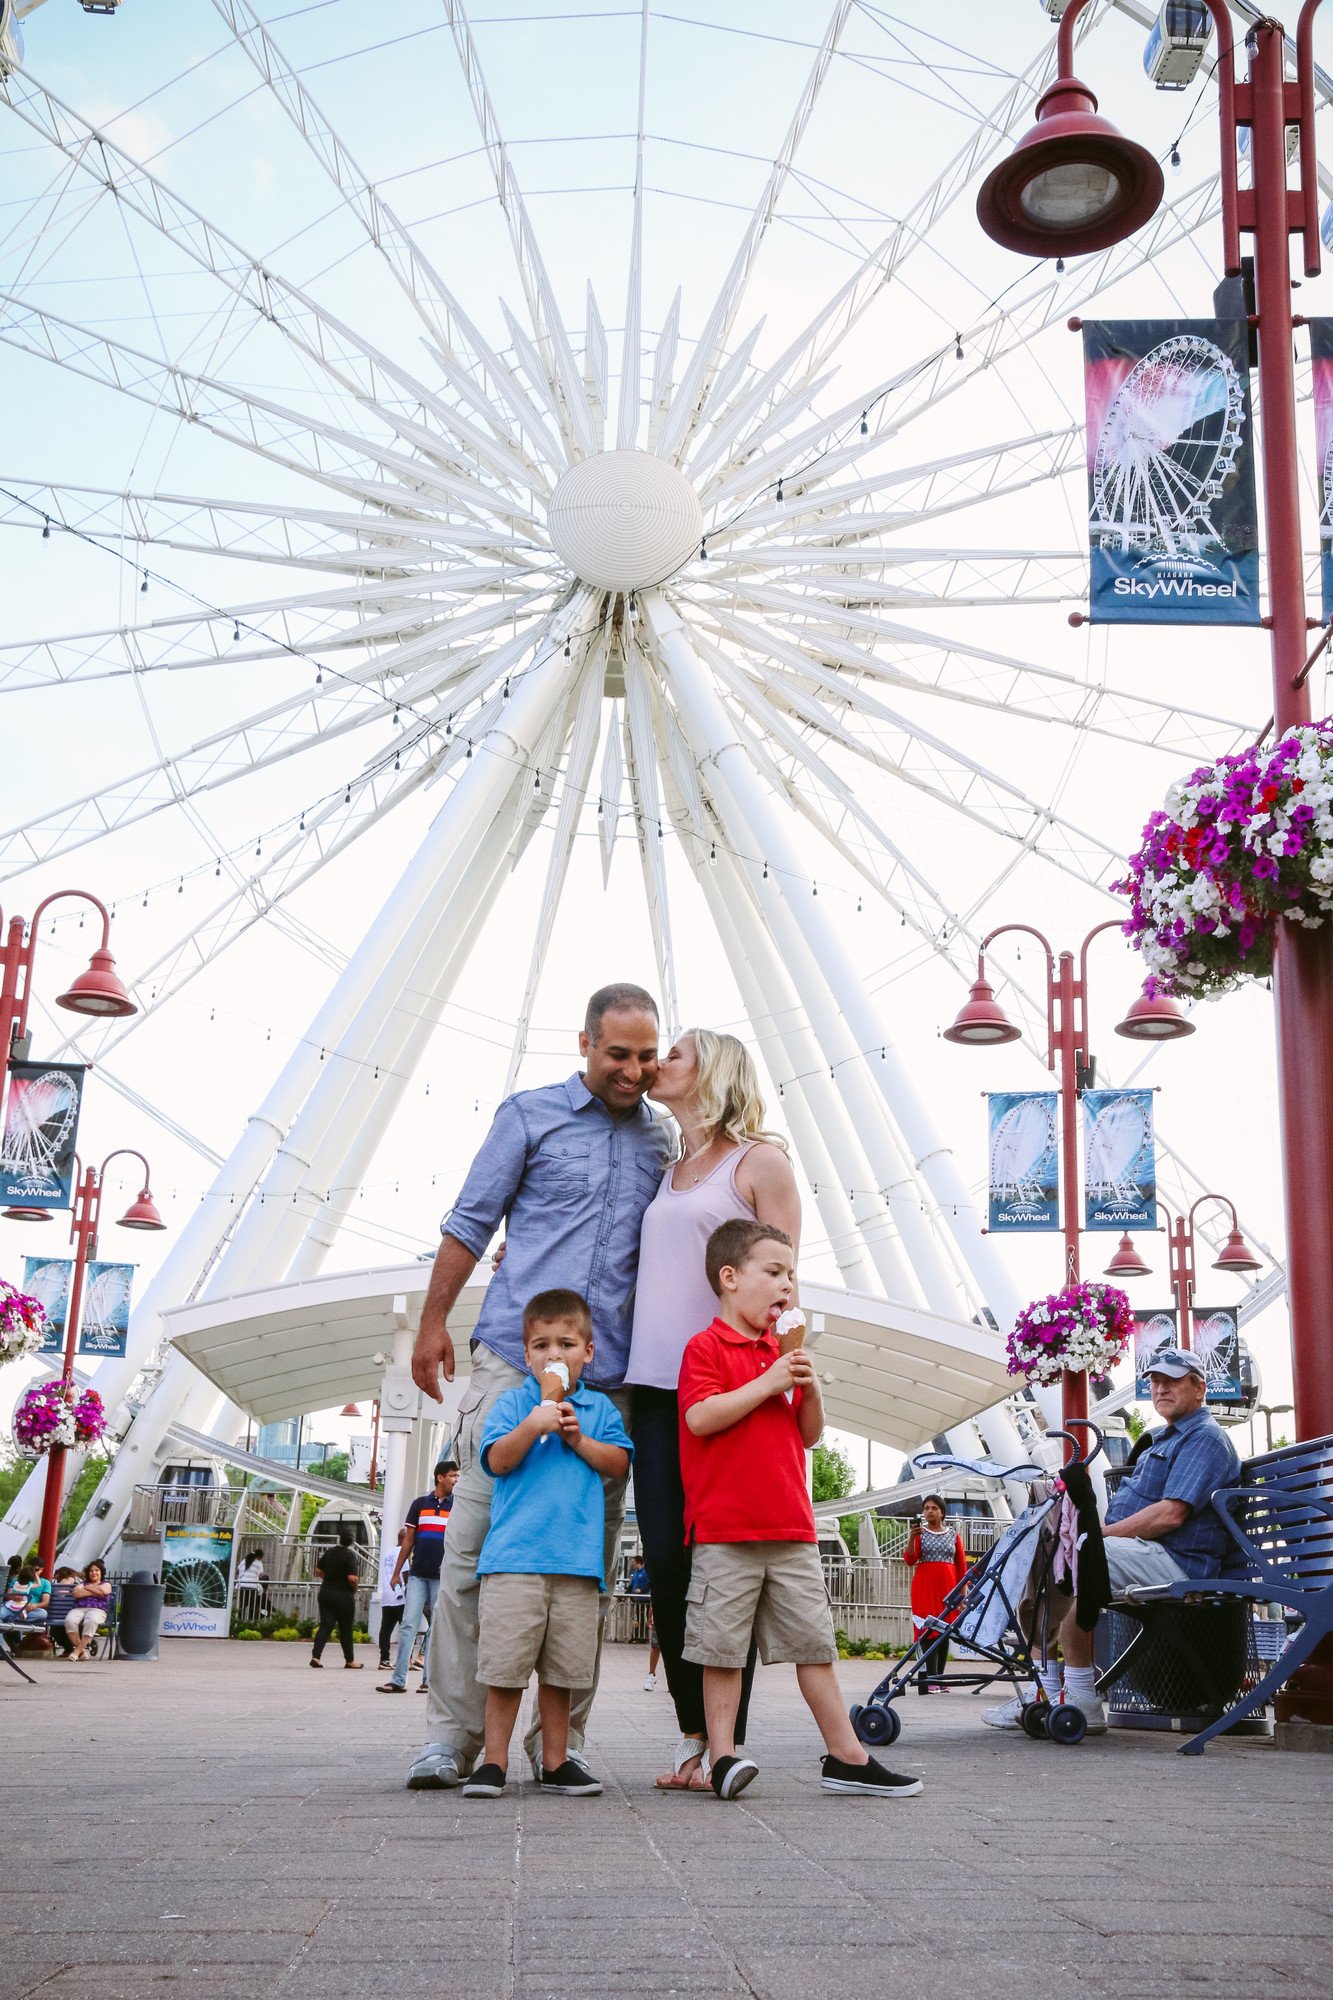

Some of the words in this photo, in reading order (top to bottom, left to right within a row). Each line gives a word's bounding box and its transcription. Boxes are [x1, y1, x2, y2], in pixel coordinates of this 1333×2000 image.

[1113, 577, 1237, 599] SkyWheel
[6, 1185, 62, 1198] SkyWheel
[998, 1212, 1050, 1223] SkyWheel
[1094, 1211, 1148, 1222] SkyWheel
[85, 1341, 120, 1351] SkyWheel
[163, 1621, 217, 1632] SkyWheel
